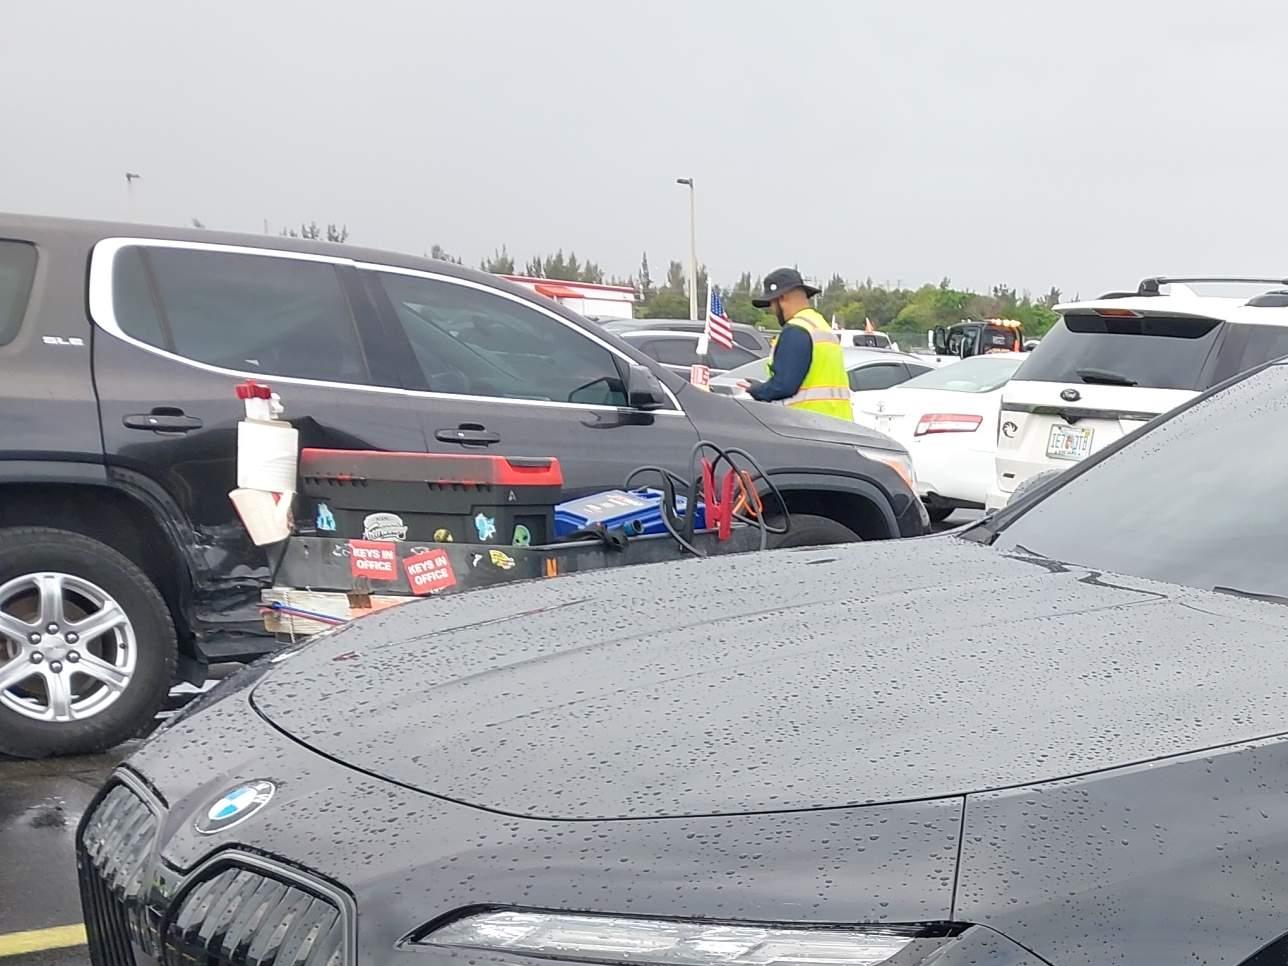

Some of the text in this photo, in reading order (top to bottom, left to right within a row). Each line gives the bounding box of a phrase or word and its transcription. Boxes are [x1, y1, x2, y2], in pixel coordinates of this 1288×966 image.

[353, 548, 394, 560] KEYS IN
[356, 560, 392, 571] OFFICE
[408, 556, 448, 575] KEYS IN
[414, 568, 448, 585] OFFICE
